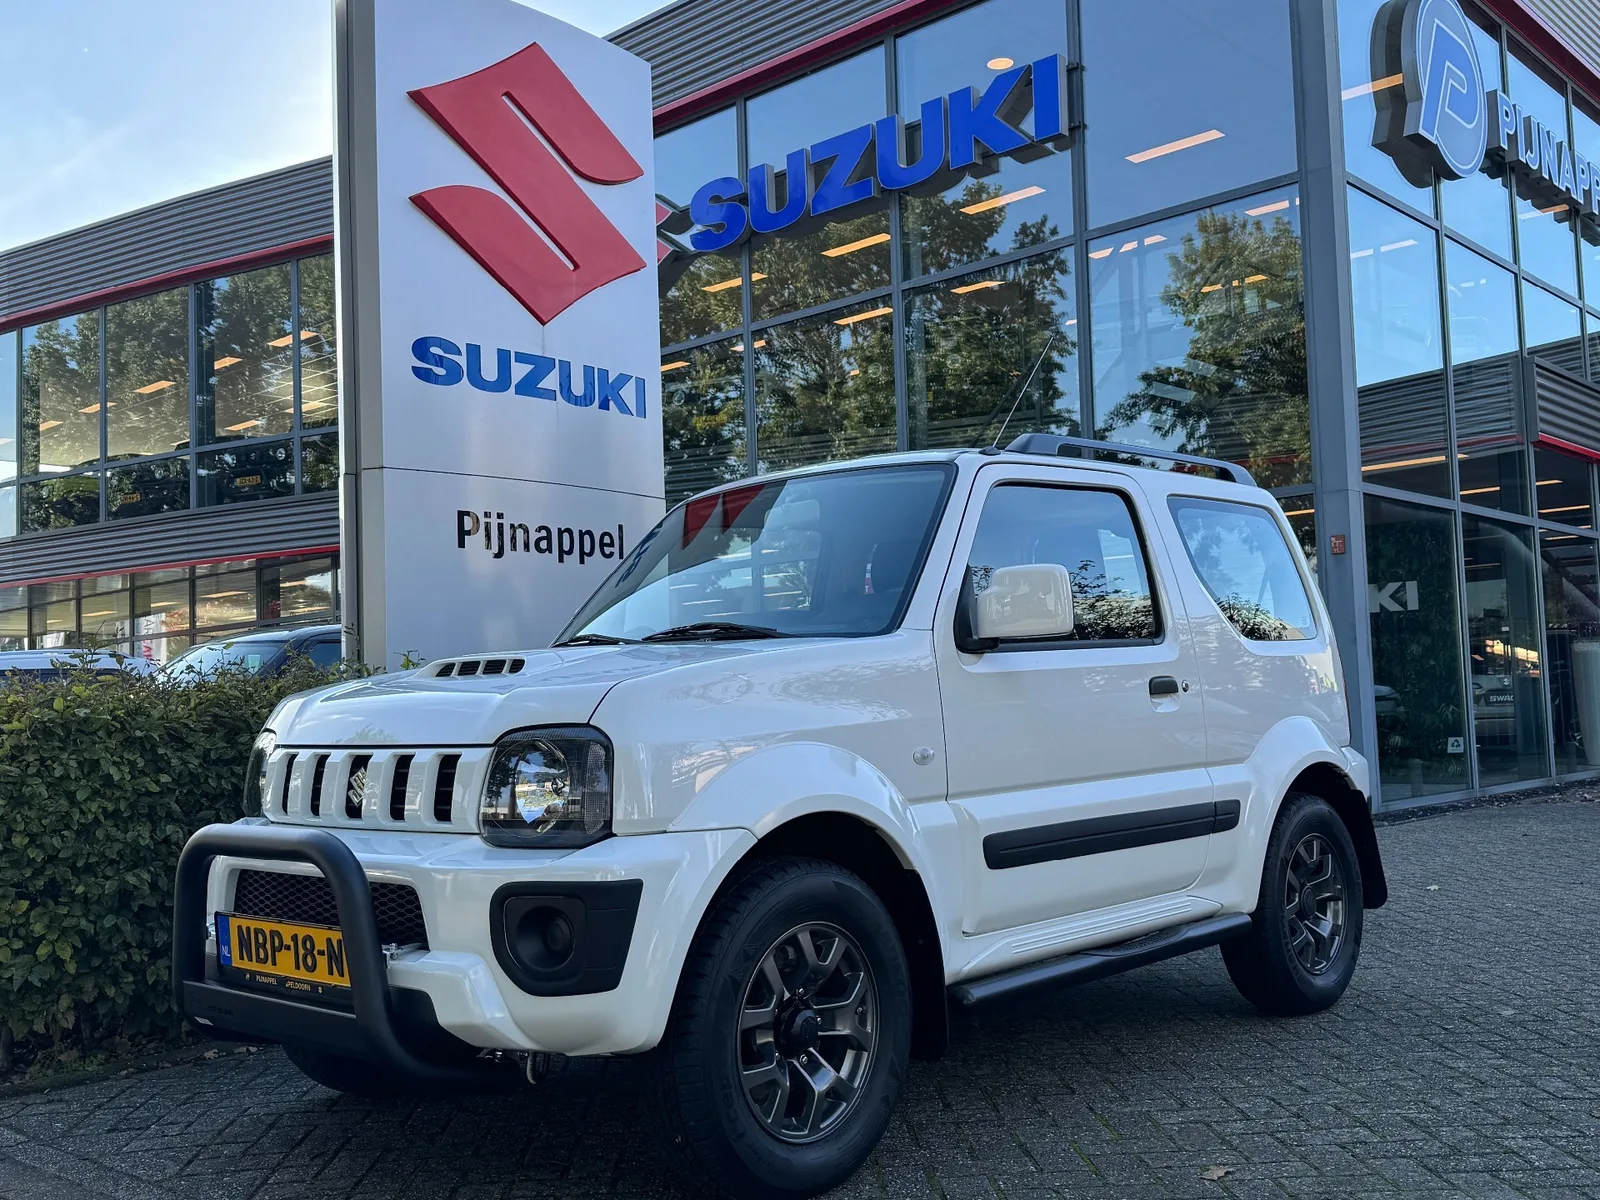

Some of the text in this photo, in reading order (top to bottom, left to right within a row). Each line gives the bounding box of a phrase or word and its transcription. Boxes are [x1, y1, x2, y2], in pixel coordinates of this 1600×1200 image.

[690, 53, 1066, 252] SUZUKI
[411, 335, 648, 420] SUZUKI
[456, 509, 625, 565] Pijnappel
[221, 944, 231, 957] NL
[236, 924, 345, 978] NBP-18-N
